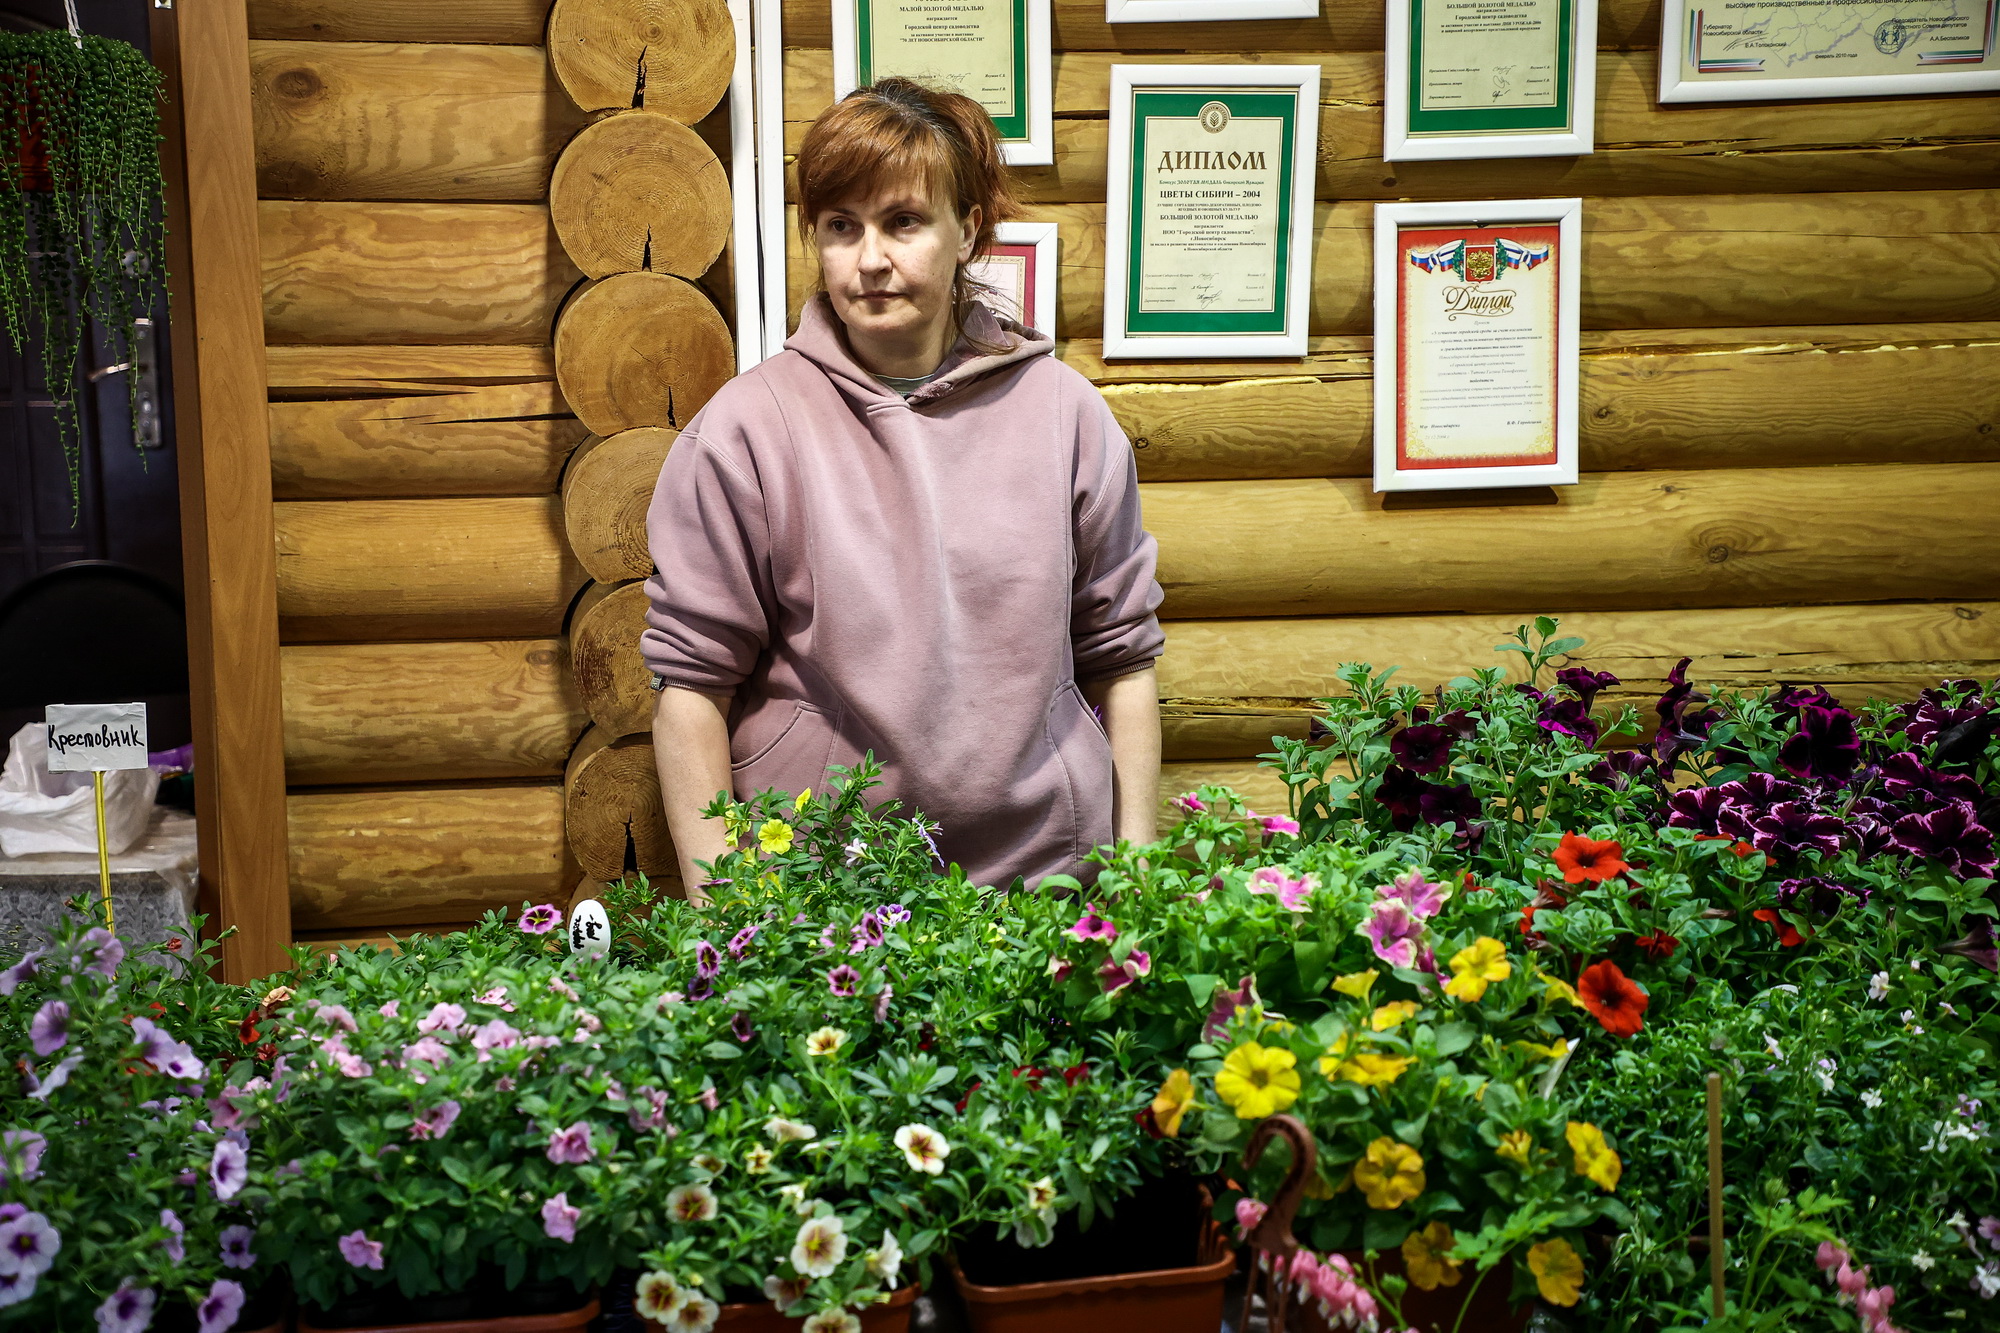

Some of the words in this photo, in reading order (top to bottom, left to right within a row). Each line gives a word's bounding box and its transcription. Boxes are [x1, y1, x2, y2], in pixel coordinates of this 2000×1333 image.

[1757, 0, 1825, 8] производственные
[1158, 151, 1267, 174] ДИПЛОМ
[1160, 190, 1193, 198] ЦВЕТЫ
[1195, 190, 1234, 198] СИБИРИ
[1242, 190, 1261, 198] 2004
[1442, 286, 1517, 319] Диплом
[48, 724, 145, 755] Крестовник
